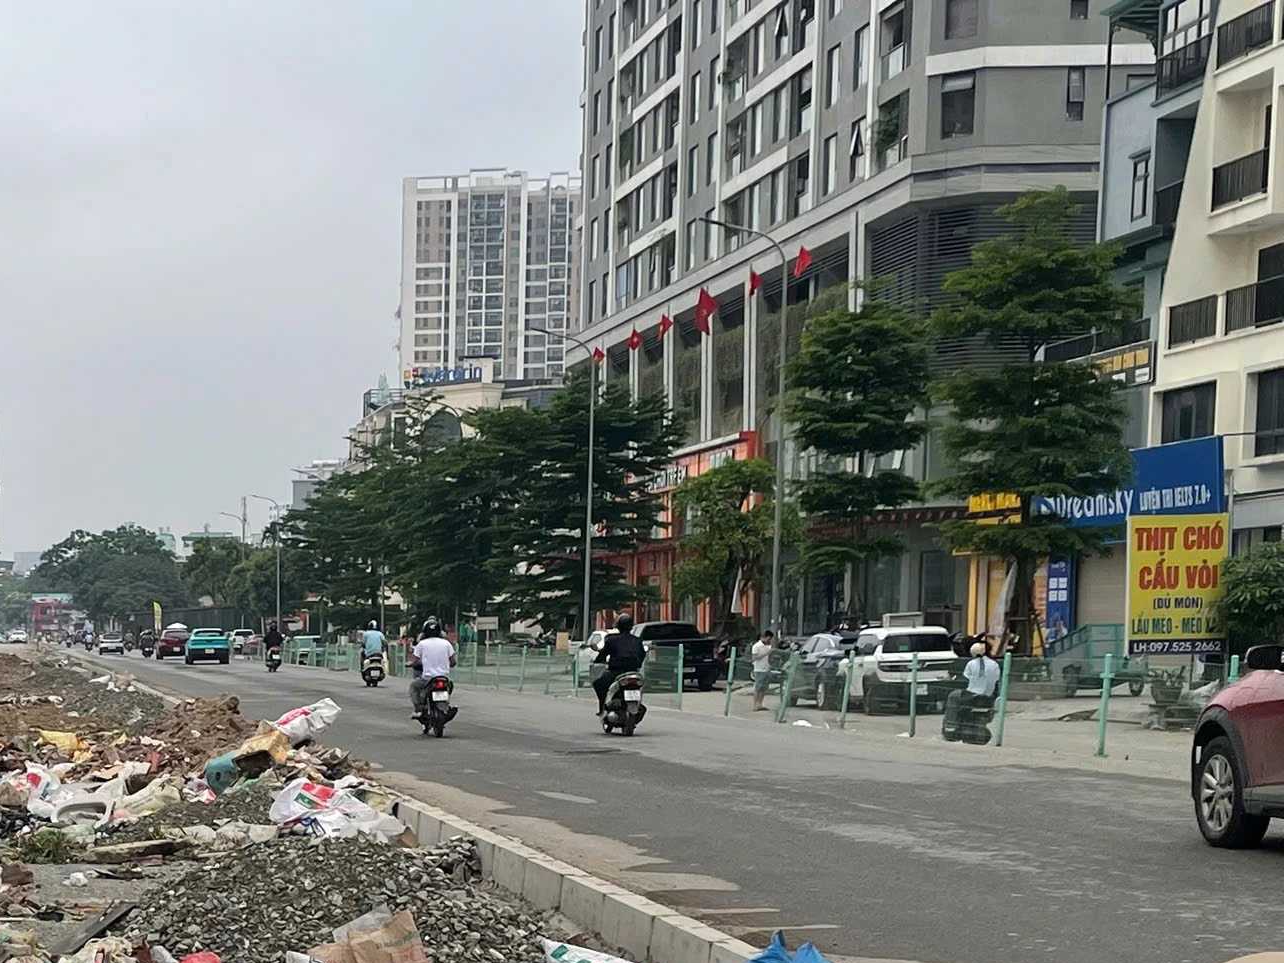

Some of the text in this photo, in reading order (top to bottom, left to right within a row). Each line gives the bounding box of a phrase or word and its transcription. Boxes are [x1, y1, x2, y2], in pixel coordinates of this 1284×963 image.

[1162, 488, 1174, 508] THI
[1175, 486, 1194, 508] IELTS
[1135, 520, 1224, 556] THỊT CHÓ
